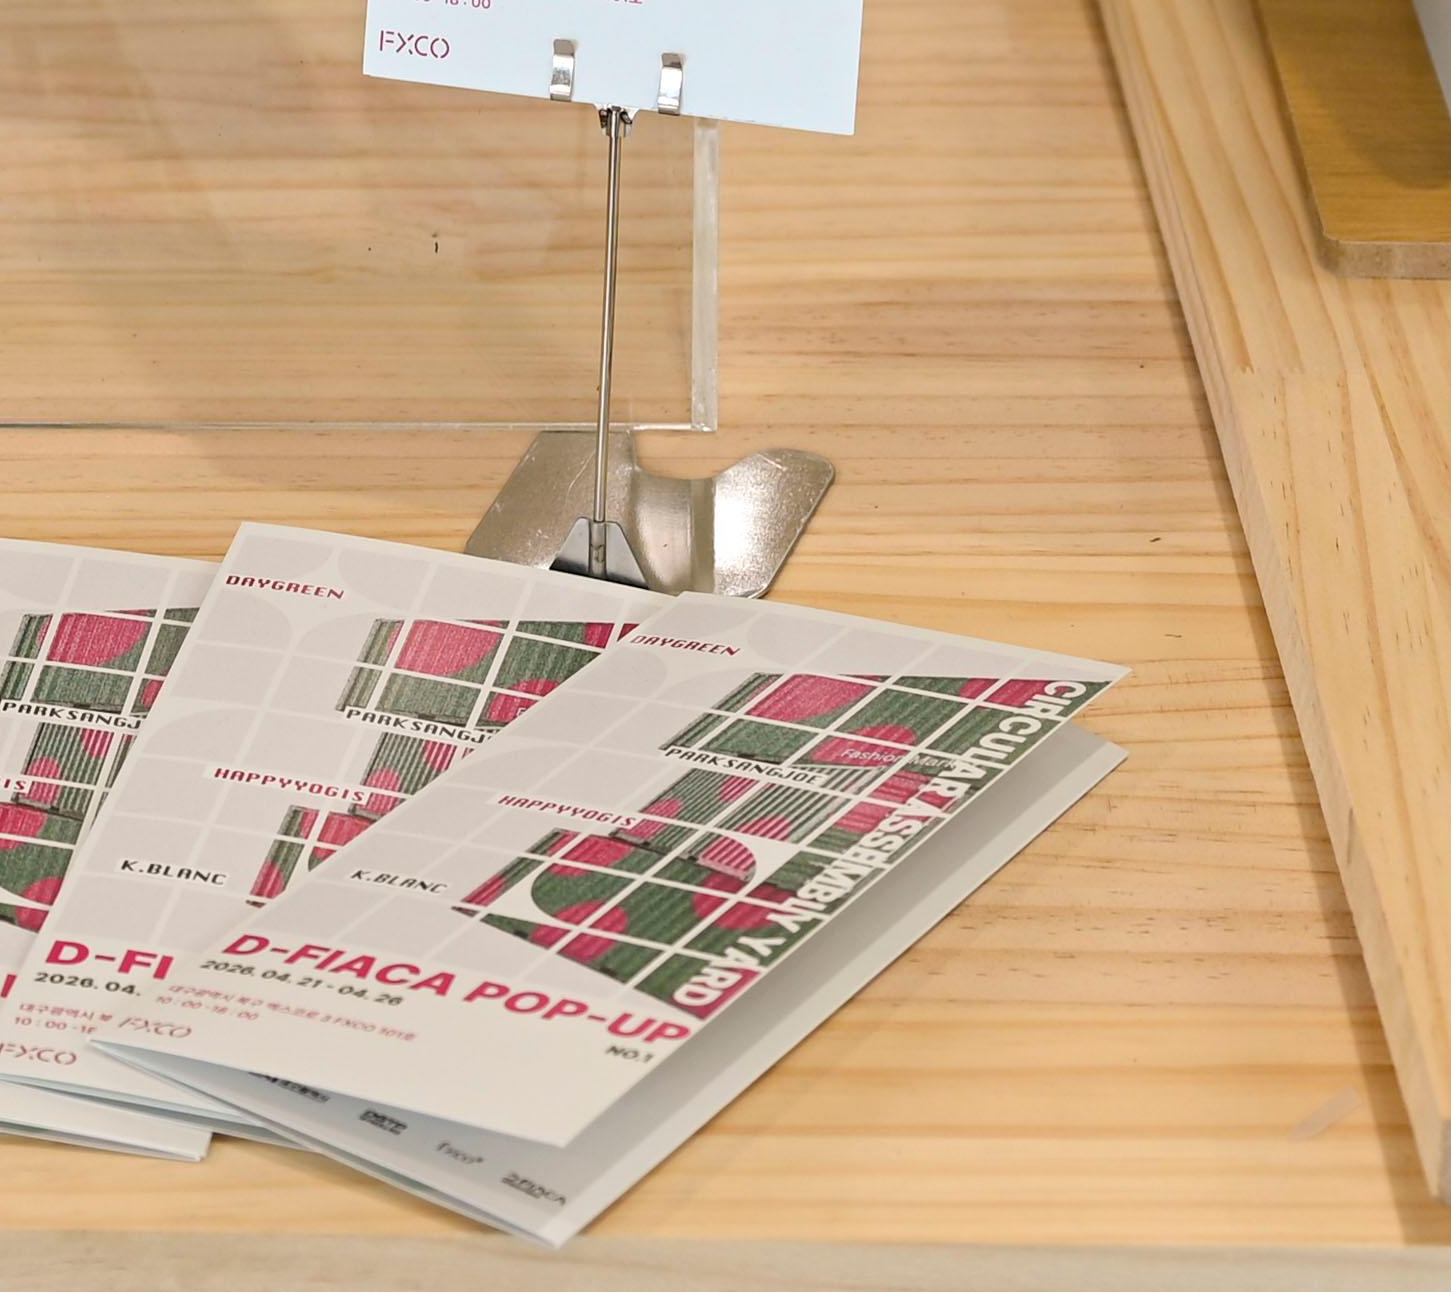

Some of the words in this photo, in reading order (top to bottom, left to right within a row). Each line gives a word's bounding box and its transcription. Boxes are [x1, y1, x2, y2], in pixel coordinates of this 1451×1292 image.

[225, 575, 345, 600] DAYGREEN
[630, 634, 741, 657] DAYGREEN
[665, 747, 824, 785] PARKSANGJOE
[213, 767, 365, 803] HAPPYYOGIS
[497, 794, 639, 829] HAPPYYOGIS
[120, 859, 227, 886] K.BLANC
[351, 868, 448, 895] K.BLANC
[222, 934, 458, 998] D-FIACA
[463, 985, 693, 1044] POP-UP
